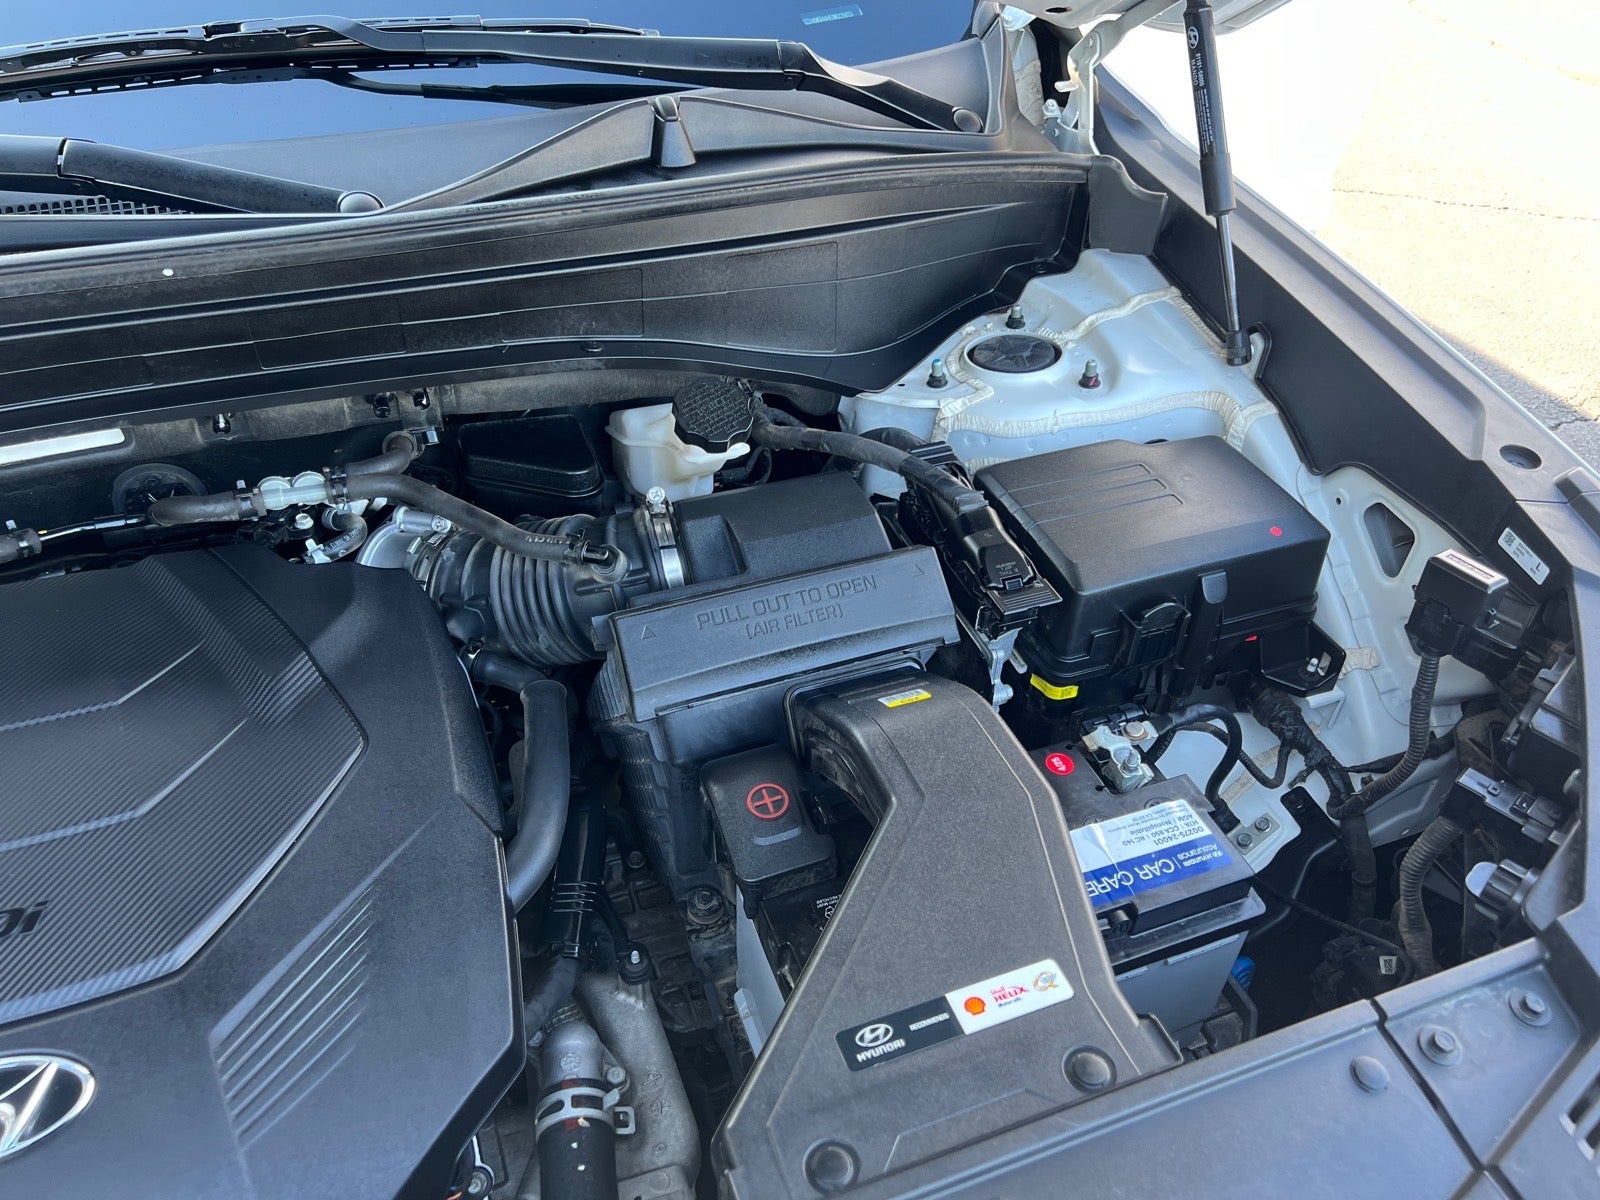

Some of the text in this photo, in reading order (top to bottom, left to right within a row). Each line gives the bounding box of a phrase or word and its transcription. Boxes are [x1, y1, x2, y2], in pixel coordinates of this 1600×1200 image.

[1536, 562, 1541, 571] L
[696, 575, 877, 630] PULL OUT TO OPEN
[1129, 813, 1194, 835] AGM Nonspillable
[1164, 825, 1180, 834] CCA
[1122, 838, 1135, 847] 140
[1153, 827, 1205, 846] 00275-24001
[1177, 843, 1218, 860] Assurance
[1085, 859, 1176, 898] CAR CARE
[993, 986, 1027, 1003] HELIX
[856, 1038, 906, 1063] HYUNDAI
